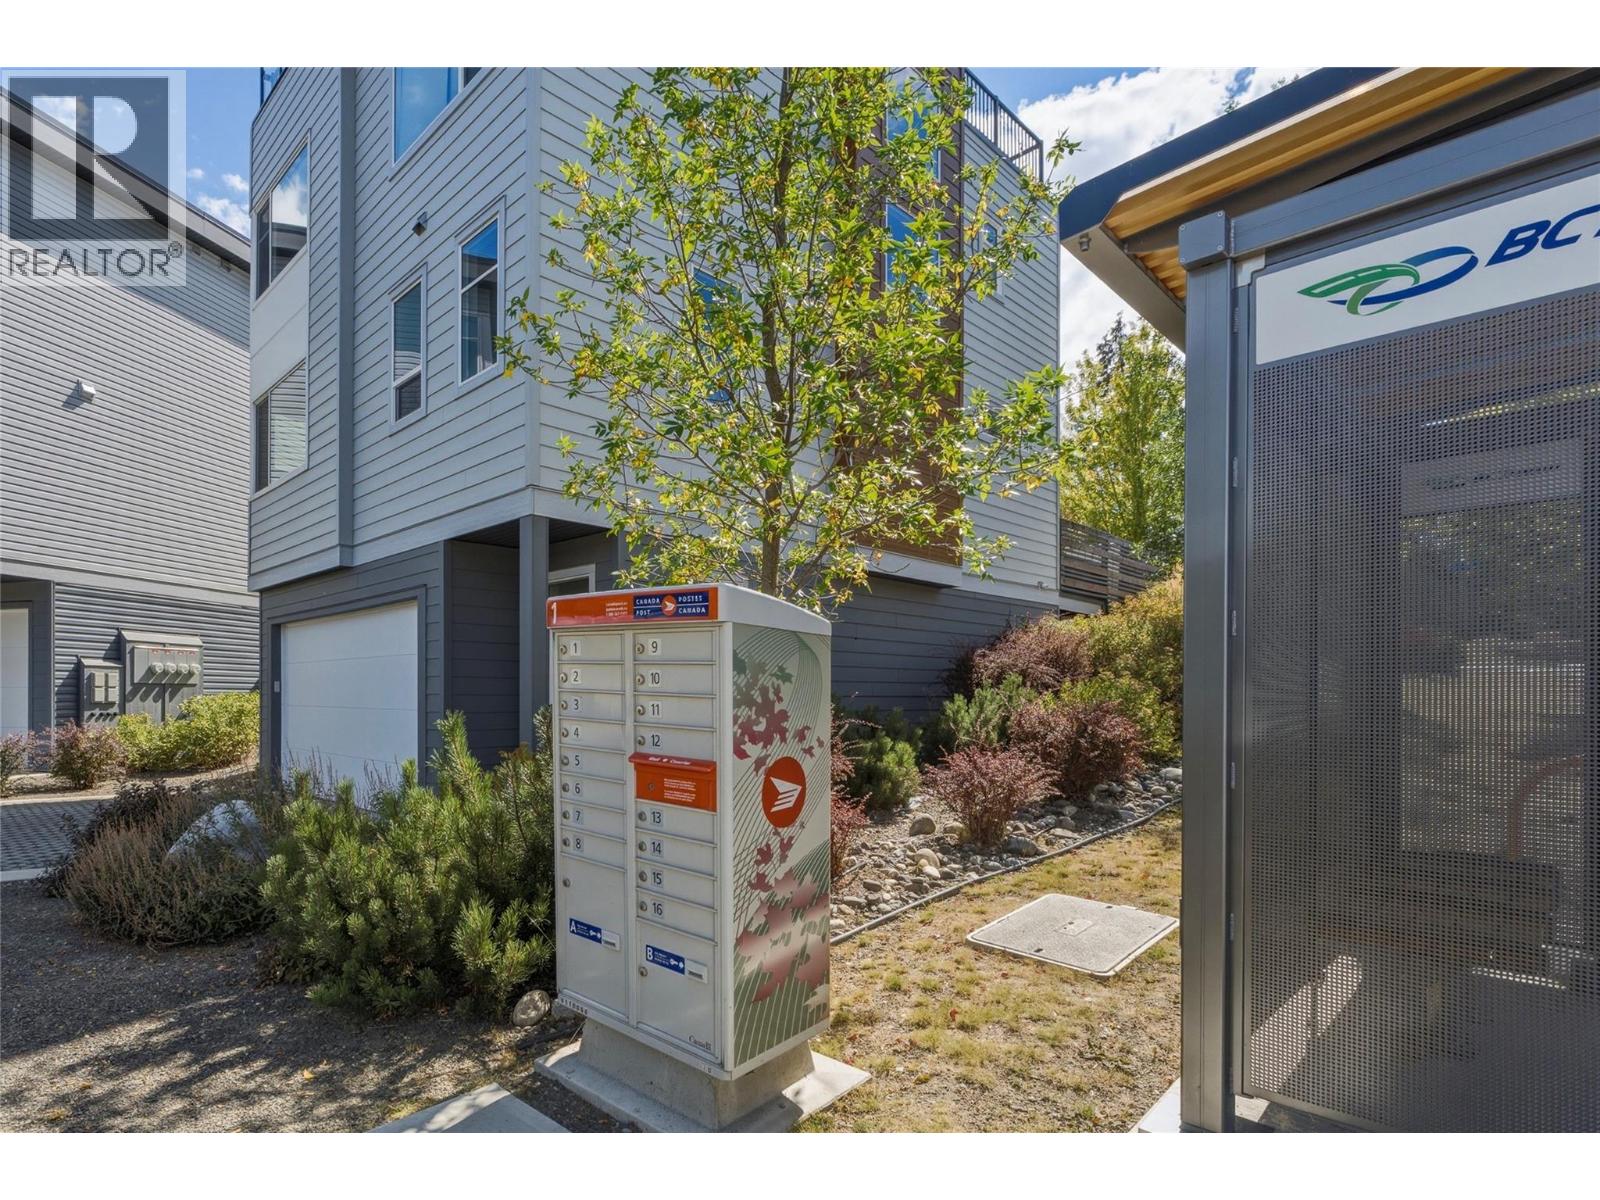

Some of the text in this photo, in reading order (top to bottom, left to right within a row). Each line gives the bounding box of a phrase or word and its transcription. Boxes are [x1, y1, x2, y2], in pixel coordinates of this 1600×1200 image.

[1486, 203, 1600, 266] BC
[551, 602, 557, 625] 1
[573, 642, 578, 653] 1
[651, 641, 658, 653] 9
[573, 671, 579, 682] 2
[651, 672, 660, 685] 10
[573, 699, 579, 710] 3
[651, 703, 660, 716] 11
[573, 727, 579, 738] 4
[651, 734, 661, 747] 12
[574, 755, 580, 766] 5
[574, 782, 581, 794] 6
[575, 811, 581, 821] 7
[651, 811, 662, 824] 13
[575, 838, 582, 849] 8
[651, 841, 662, 855] 14
[652, 871, 663, 885] 15
[652, 902, 663, 916] 16
[570, 921, 577, 933] A
[646, 947, 653, 960] B
